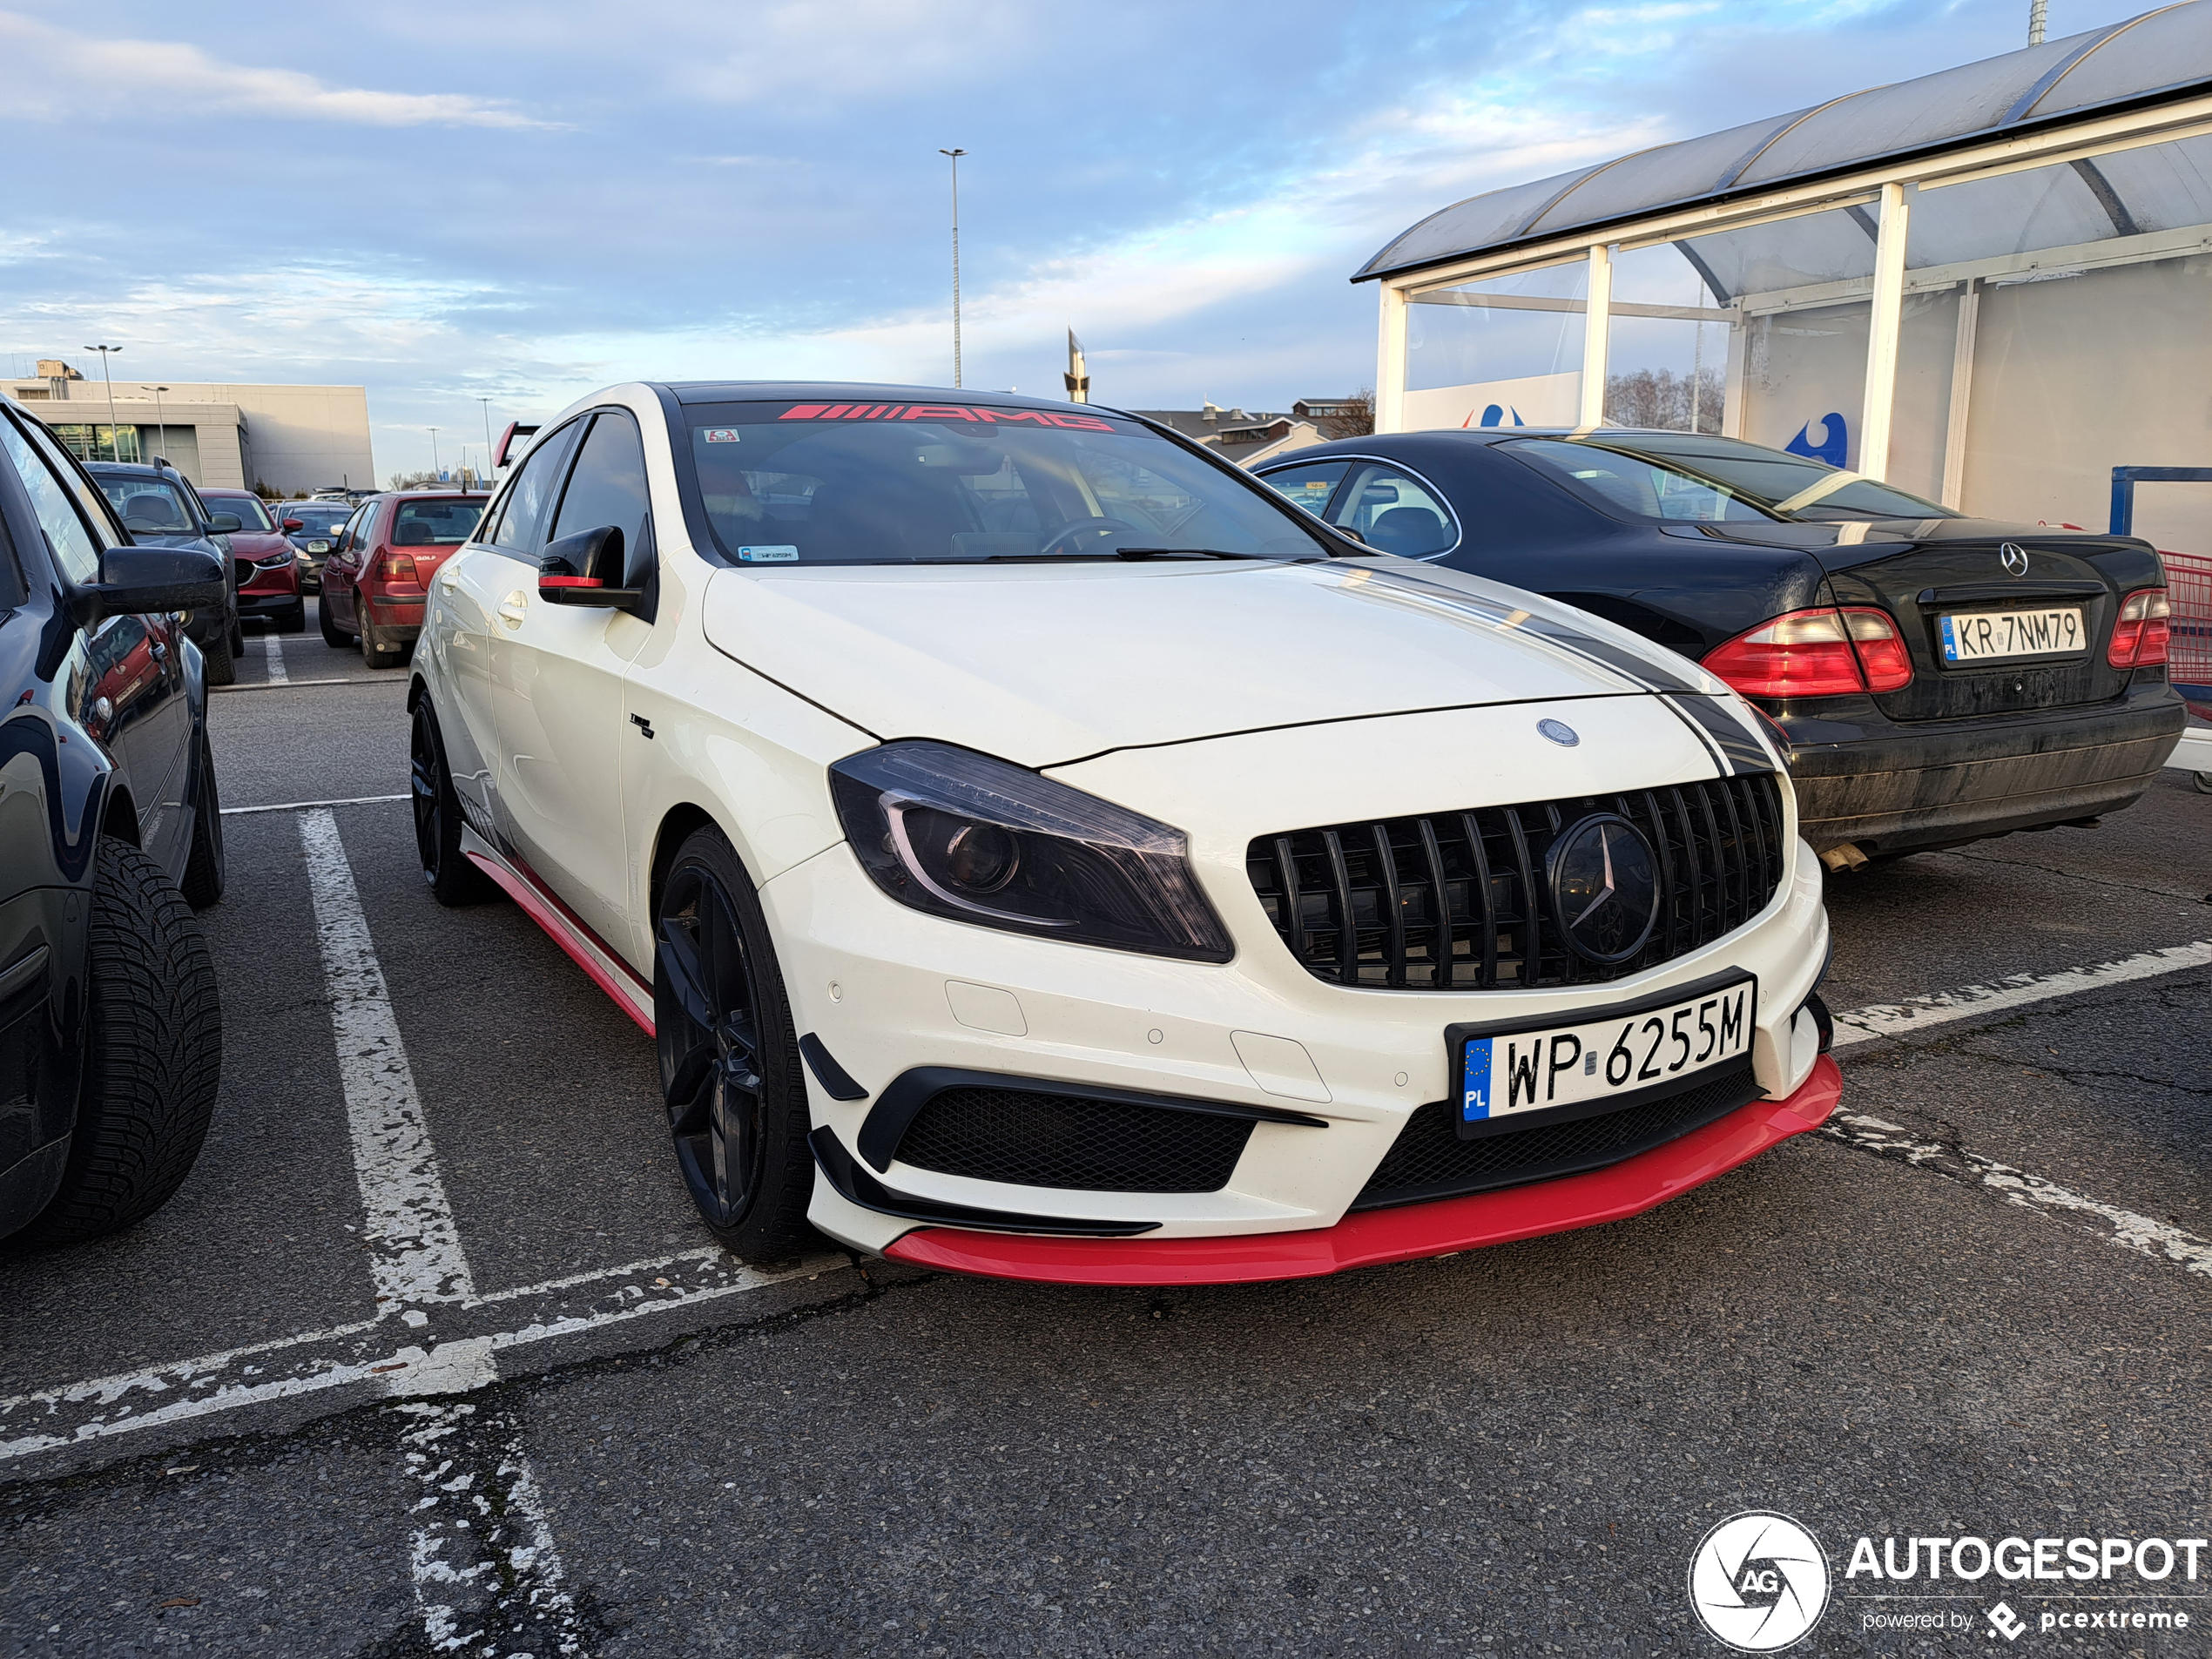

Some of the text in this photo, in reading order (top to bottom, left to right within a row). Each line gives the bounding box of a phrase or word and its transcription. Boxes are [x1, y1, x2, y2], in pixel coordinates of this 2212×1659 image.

[1944, 644, 1956, 655] PL
[1959, 612, 2077, 656] KR 7NM79
[1507, 988, 1744, 1109] WP 6255M
[1464, 1089, 1487, 1110] PL
